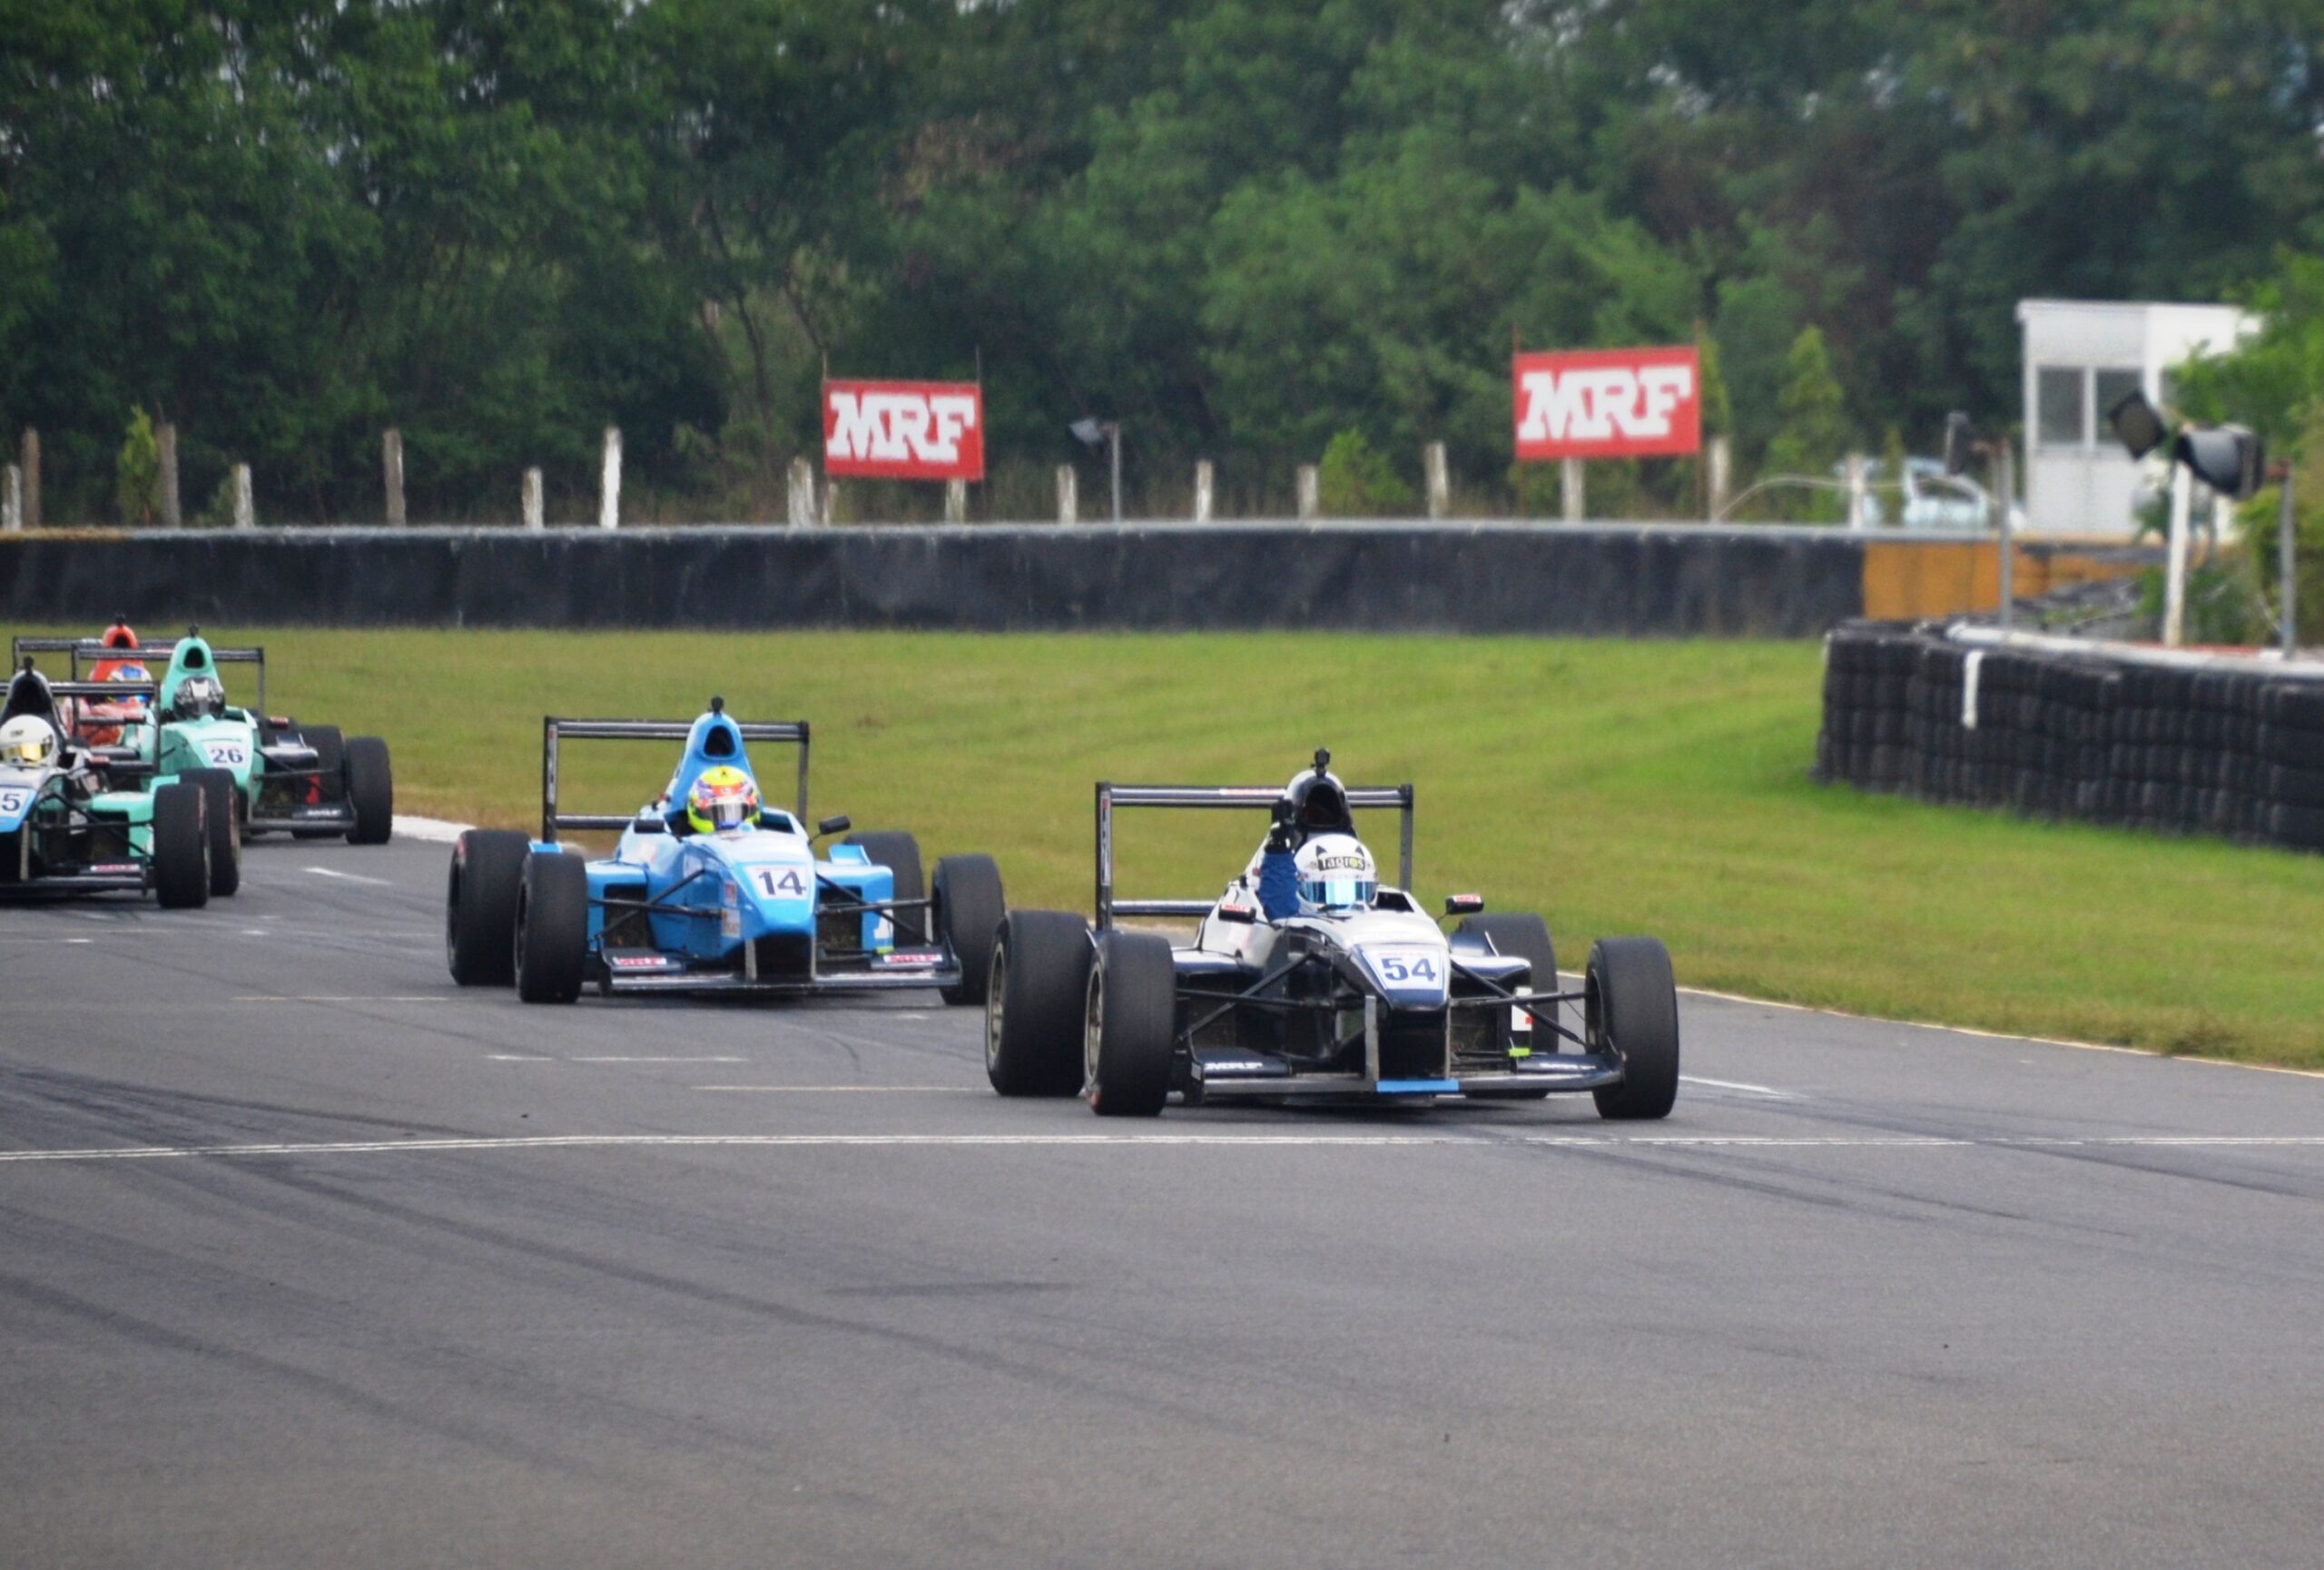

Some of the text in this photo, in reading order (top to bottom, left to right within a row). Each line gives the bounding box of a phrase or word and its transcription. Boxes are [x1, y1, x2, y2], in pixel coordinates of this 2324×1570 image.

[1518, 364, 1691, 439] MRF
[827, 391, 975, 463] MRF
[211, 748, 243, 764] 26
[1321, 856, 1364, 870] Tagros
[758, 870, 807, 895] 14
[1382, 958, 1436, 982] 54
